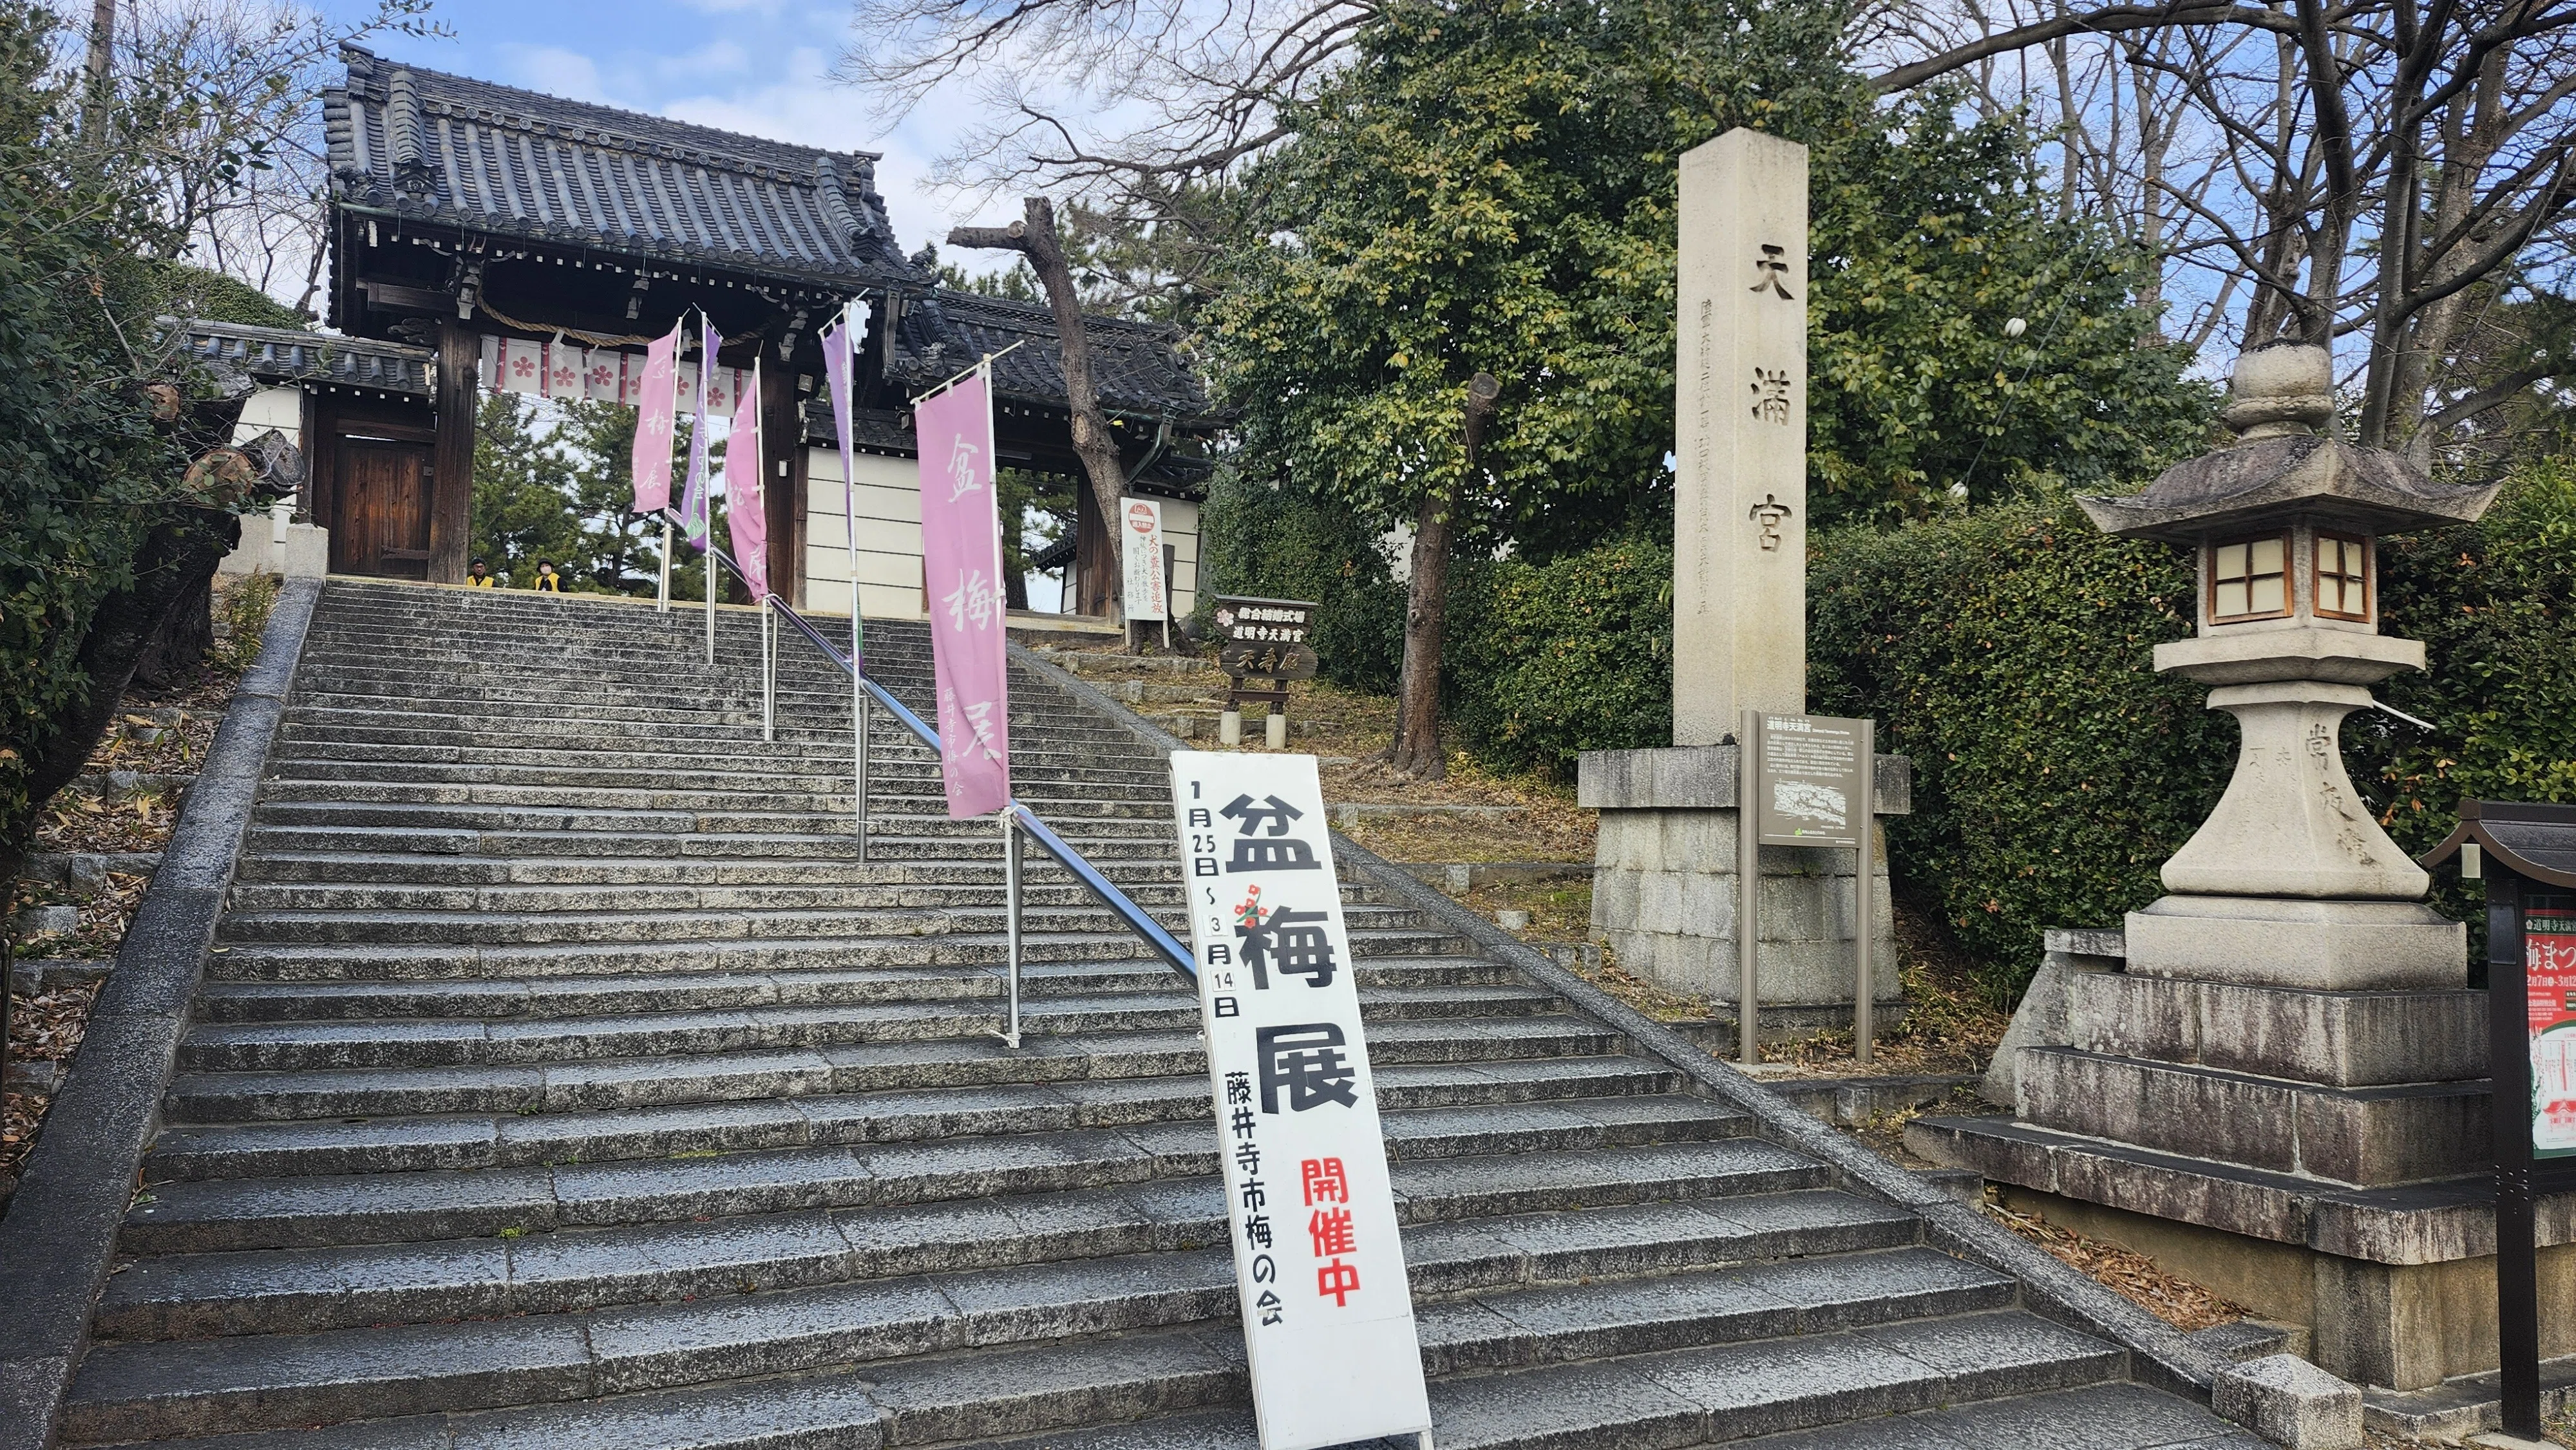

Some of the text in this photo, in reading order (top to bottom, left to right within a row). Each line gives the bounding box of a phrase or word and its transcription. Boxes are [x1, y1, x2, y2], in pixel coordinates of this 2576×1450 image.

[1233, 626, 1304, 642] 道明寺天満宮
[1238, 607, 1305, 623] 総合結婚式場
[943, 687, 964, 796] 藤井寺市梅の会
[1218, 793, 1359, 1115] 盆梅展
[1224, 1071, 1283, 1326] 藤井寺市梅の会
[1300, 1157, 1361, 1308] 開催中
